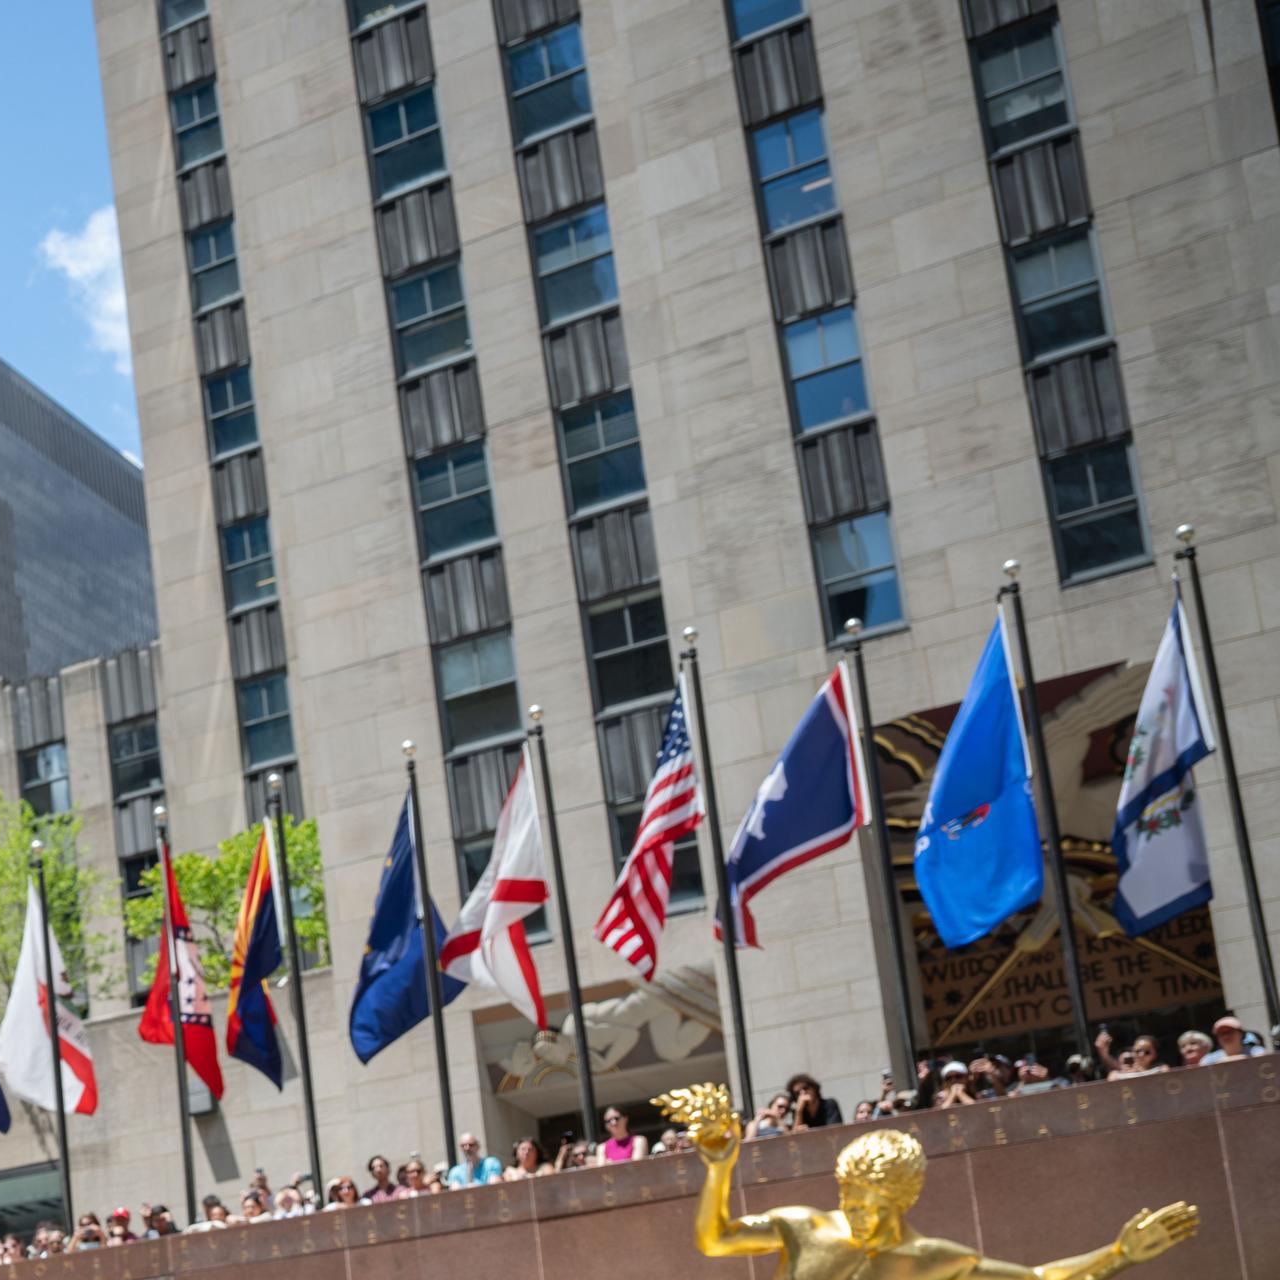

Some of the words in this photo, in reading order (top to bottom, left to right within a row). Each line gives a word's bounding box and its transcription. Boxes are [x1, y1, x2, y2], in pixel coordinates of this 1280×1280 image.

[921, 953, 1010, 983] WISDO
[1113, 951, 1151, 977] THE
[1093, 980, 1142, 1007] THY
[1153, 973, 1220, 998] TIM
